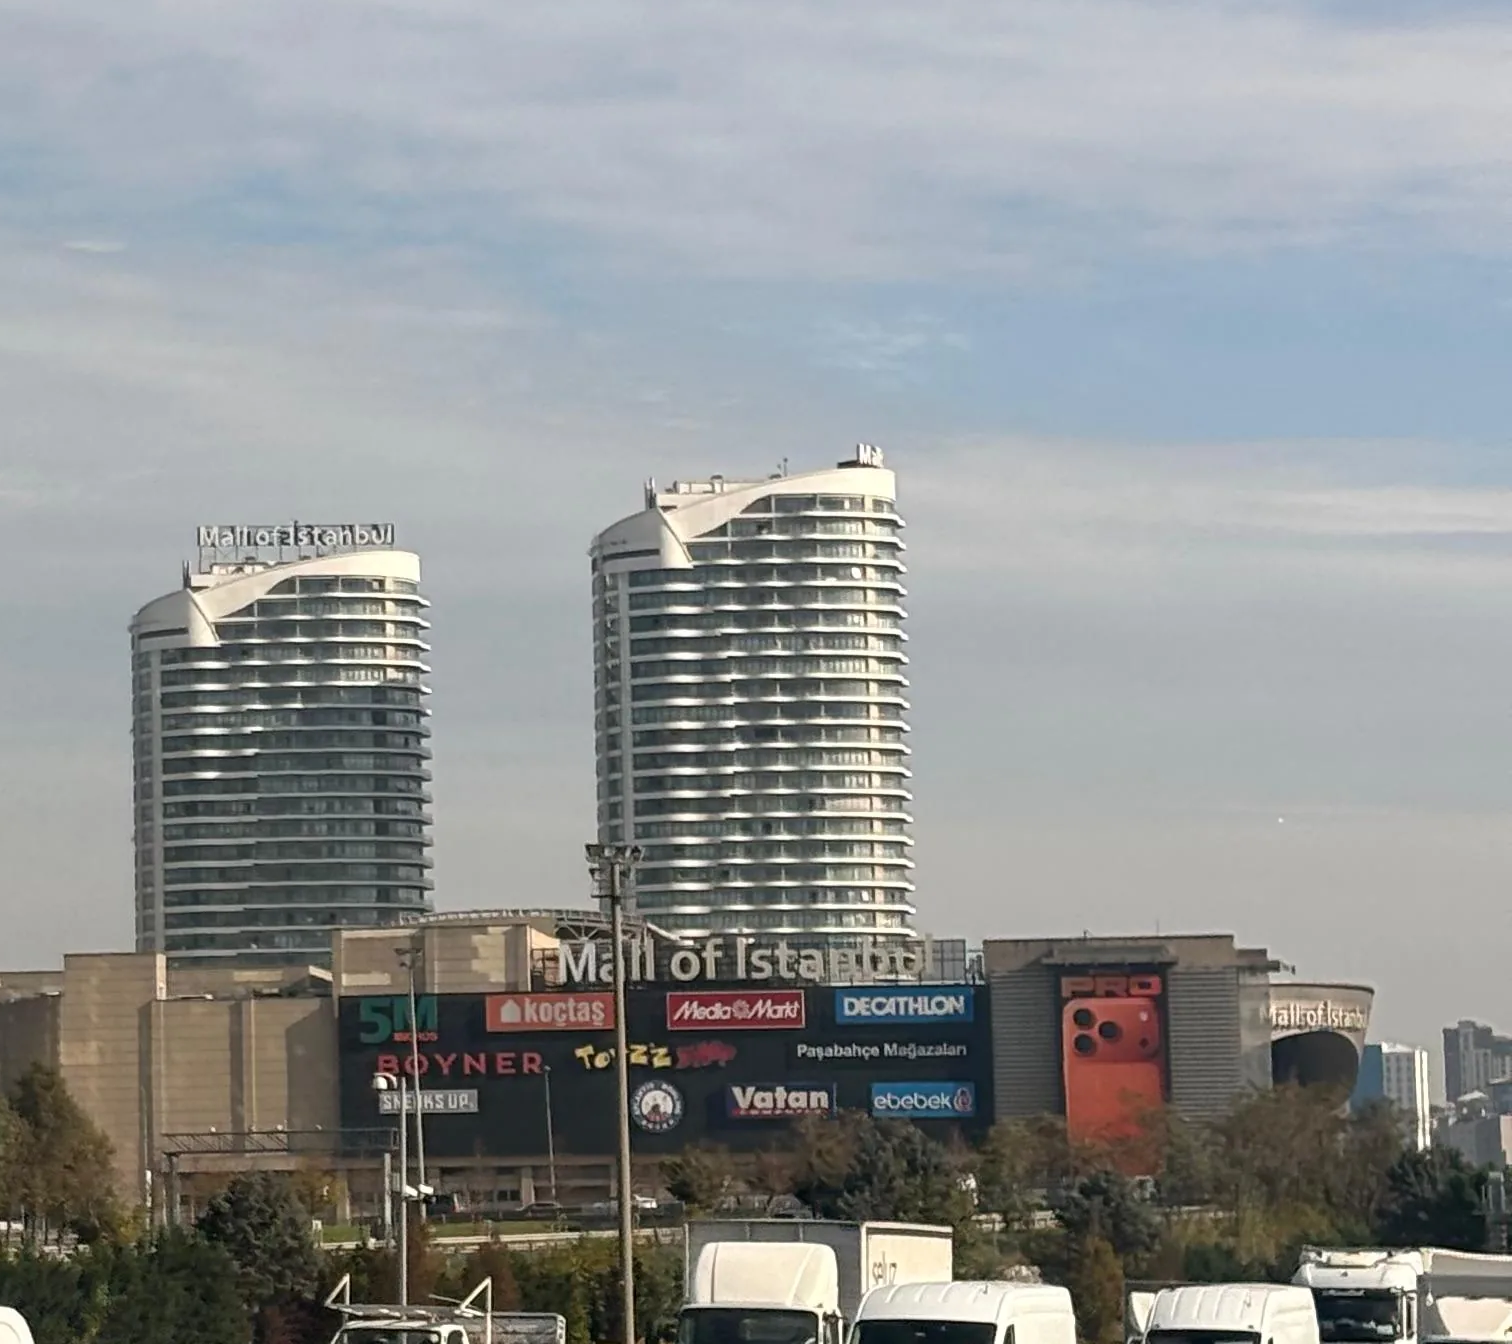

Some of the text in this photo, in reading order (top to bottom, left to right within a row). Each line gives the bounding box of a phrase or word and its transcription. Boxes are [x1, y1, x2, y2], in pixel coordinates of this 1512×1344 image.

[198, 525, 248, 546] Mall
[256, 525, 281, 546] of
[670, 937, 724, 982] of
[524, 997, 606, 1027] koçtaş
[843, 994, 965, 1017] DECATHLON
[360, 995, 438, 1043] 5M
[377, 1052, 544, 1077] BOYNER
[731, 1086, 829, 1109] Vatan
[874, 1092, 952, 1110] ebebek
